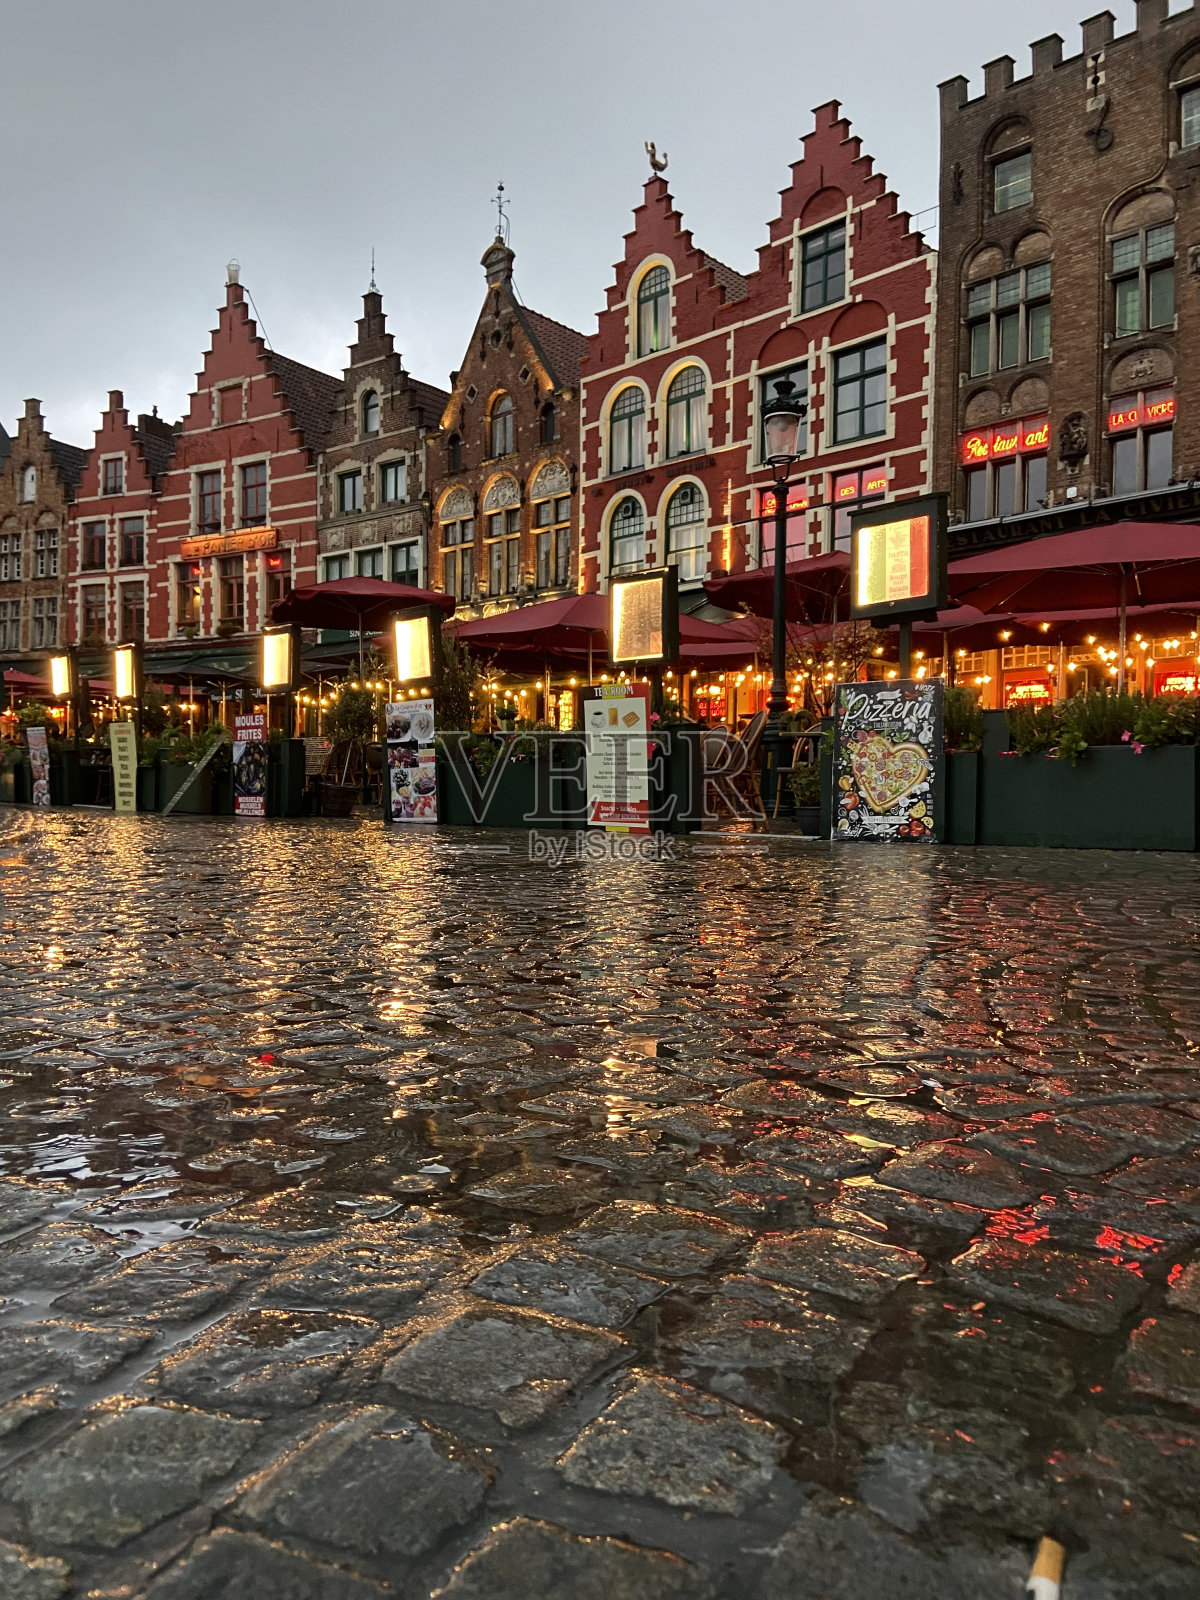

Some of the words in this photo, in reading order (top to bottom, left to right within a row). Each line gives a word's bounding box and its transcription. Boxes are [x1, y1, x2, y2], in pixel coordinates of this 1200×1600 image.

[1112, 413, 1124, 426] LA
[840, 486, 855, 497] DES
[866, 479, 887, 491] ARTS
[203, 537, 243, 555] PANIER
[594, 687, 608, 697] TEA
[611, 685, 634, 696] ROOM
[841, 693, 932, 731] Pizzeria
[235, 715, 264, 727] MOULES
[237, 729, 262, 740] FRITES
